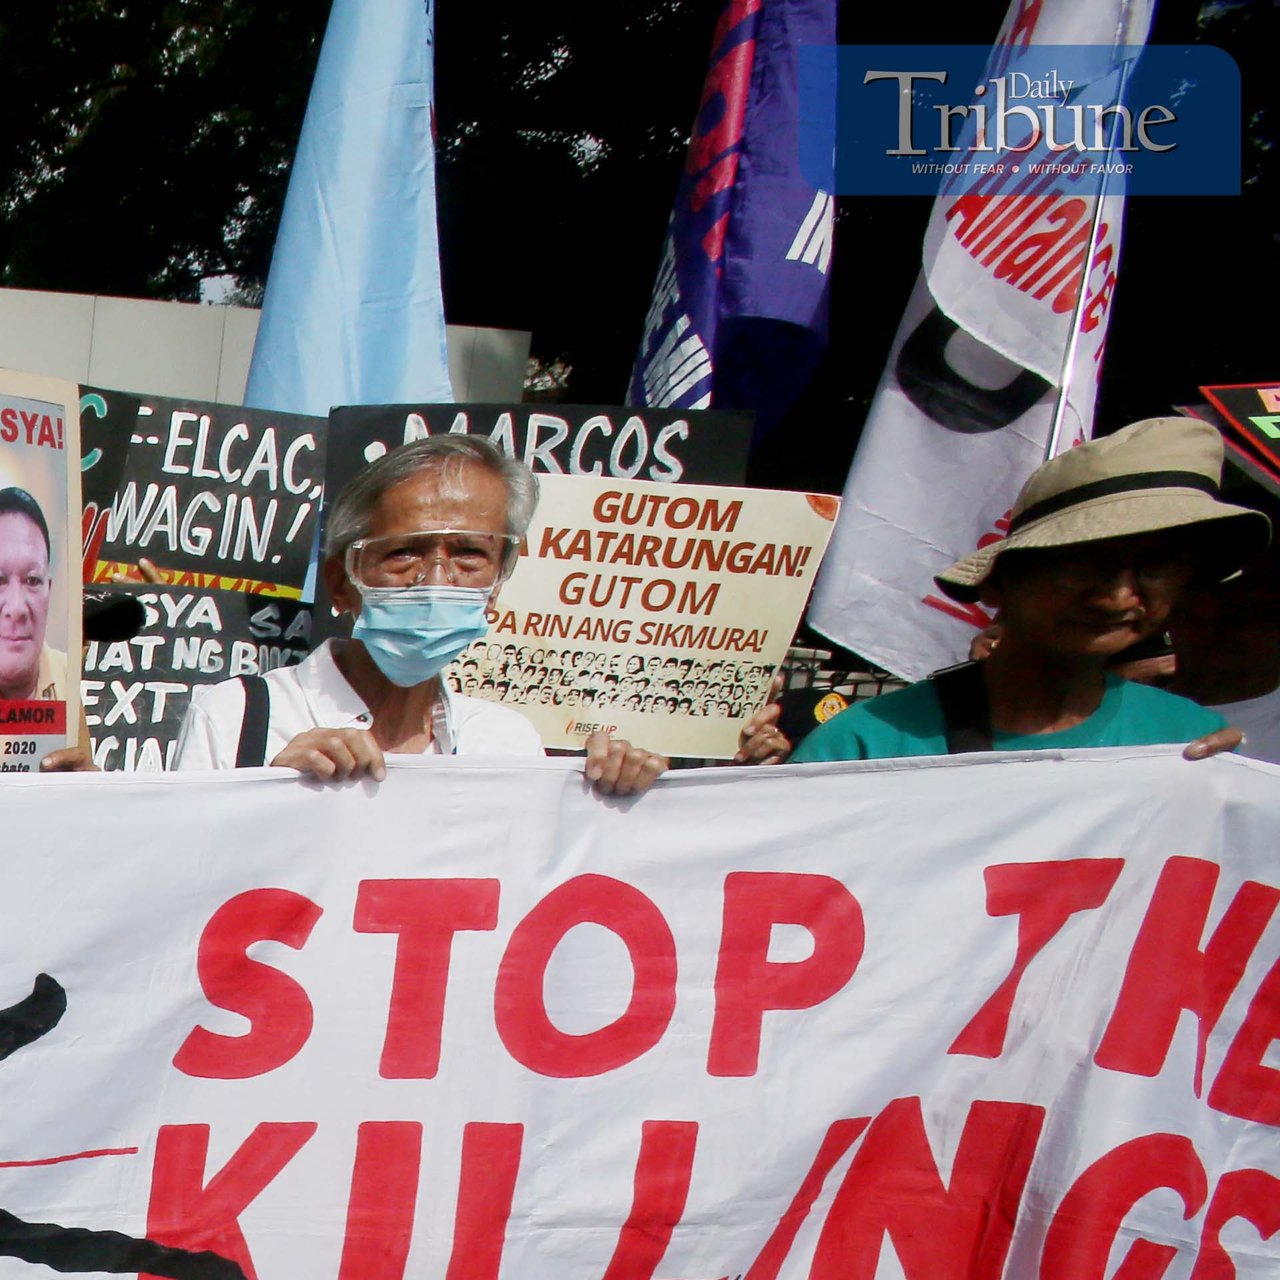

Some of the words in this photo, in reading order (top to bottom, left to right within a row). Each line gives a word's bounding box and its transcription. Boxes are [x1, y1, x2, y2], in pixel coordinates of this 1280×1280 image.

[593, 491, 743, 533] GUTOM
[538, 527, 812, 578] KATARUNGAN!
[559, 572, 721, 616] GUTOM
[523, 612, 574, 638] RIN
[574, 617, 633, 644] ANG
[636, 621, 768, 653] SIKMURA!
[172, 637, 224, 673] NG
[80, 680, 212, 726] EXT
[4, 742, 37, 755] 2020
[172, 872, 866, 1081] STOP
